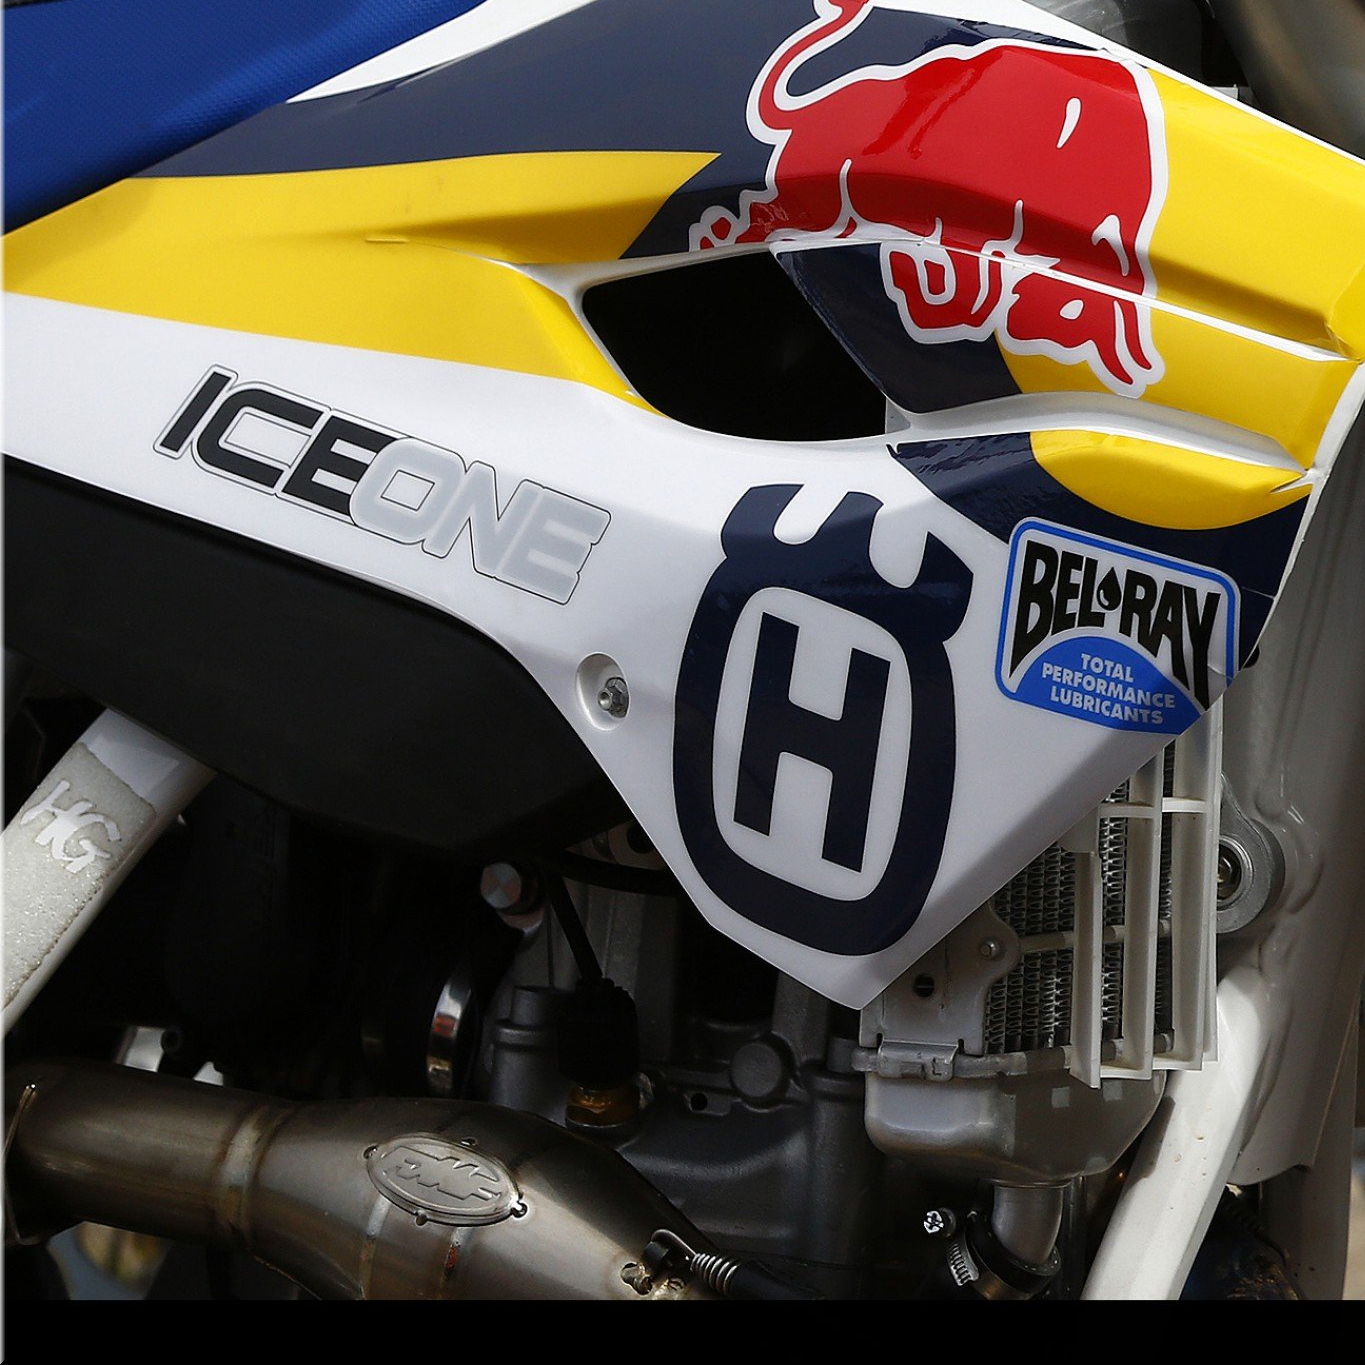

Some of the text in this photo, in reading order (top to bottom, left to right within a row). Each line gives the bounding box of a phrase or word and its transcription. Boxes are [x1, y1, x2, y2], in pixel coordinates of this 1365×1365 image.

[1041, 661, 1176, 709] PERFORMANCE
[1080, 652, 1135, 683] TOTAL
[1050, 685, 1164, 725] LUBRICANTS
